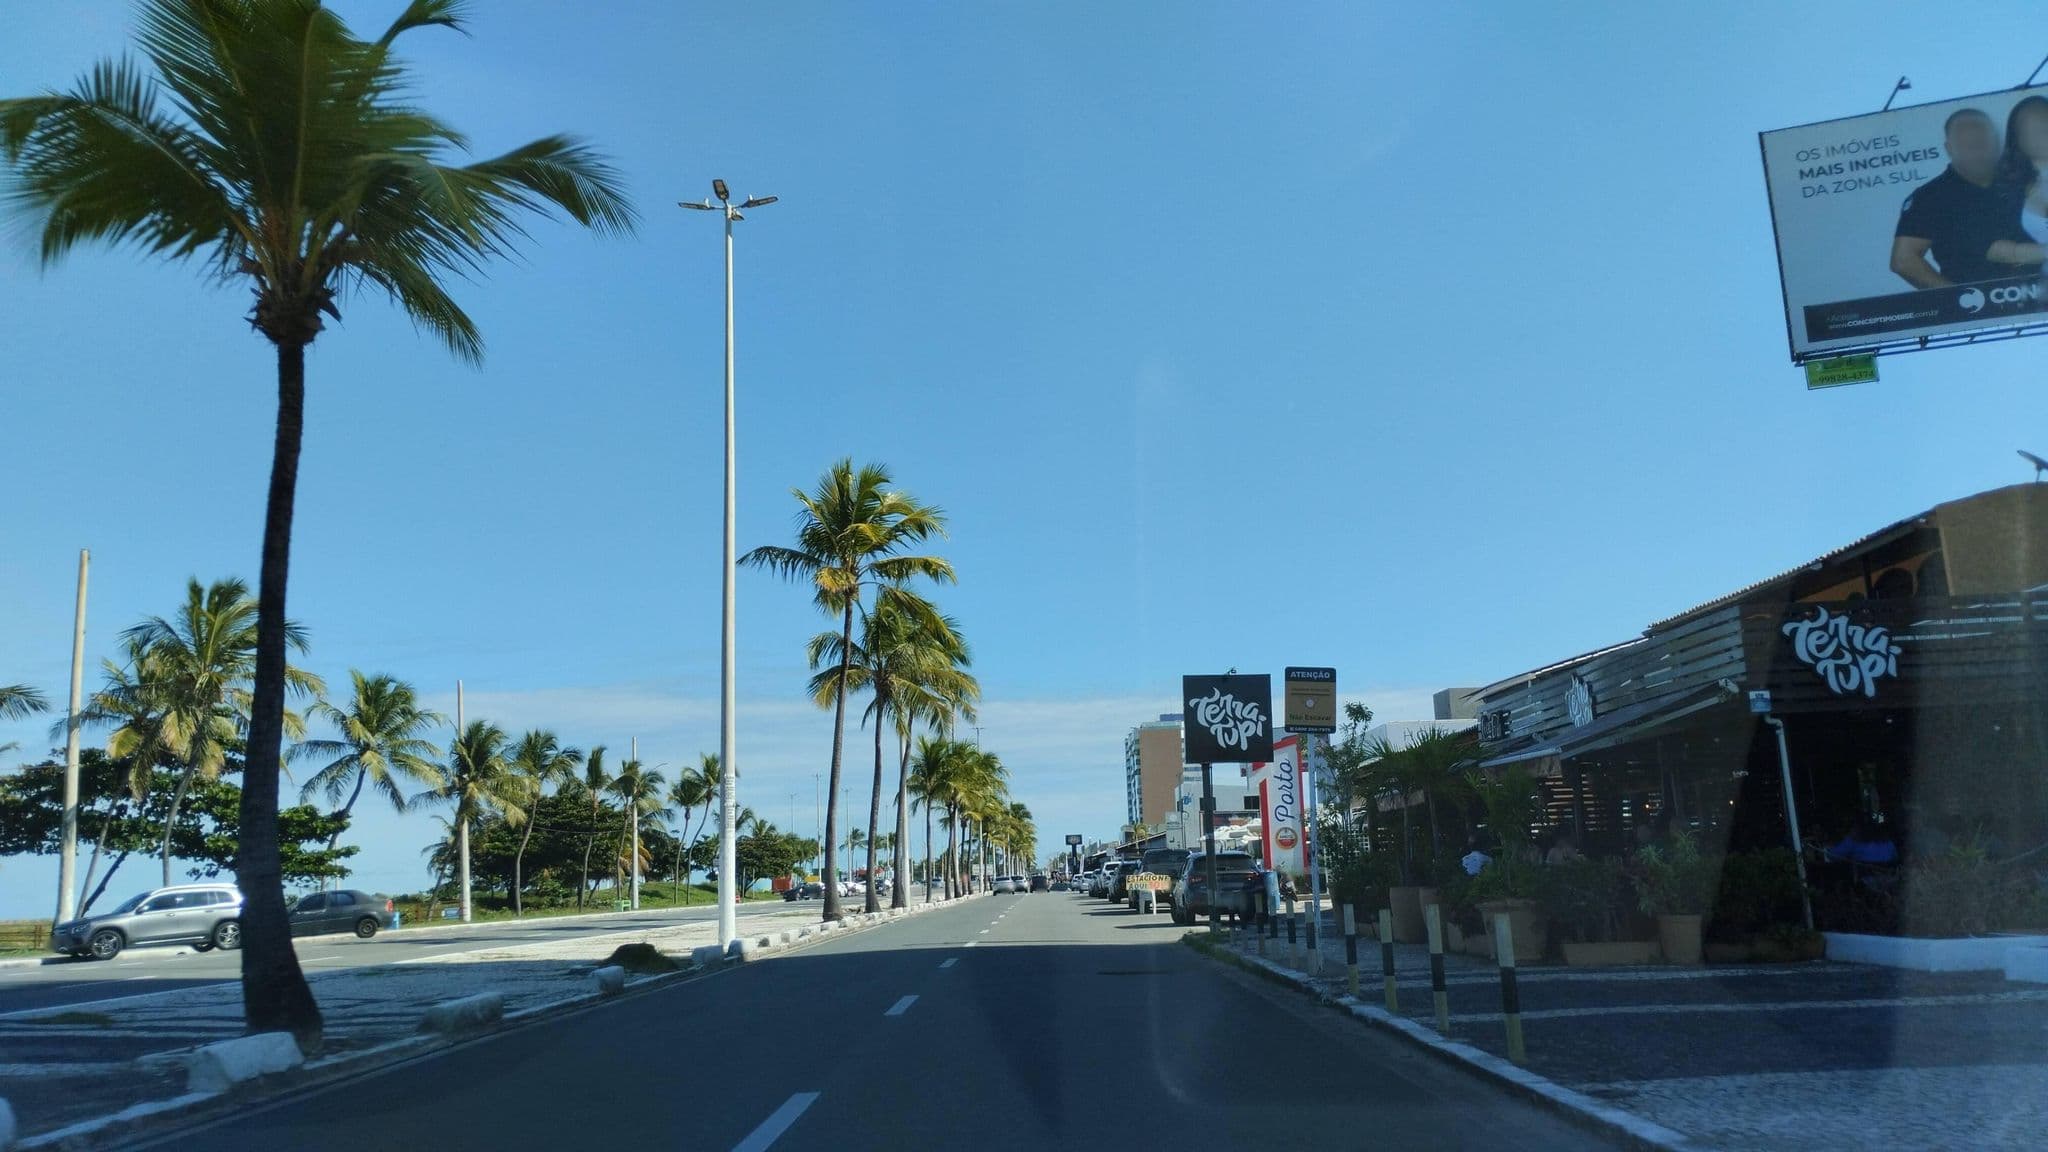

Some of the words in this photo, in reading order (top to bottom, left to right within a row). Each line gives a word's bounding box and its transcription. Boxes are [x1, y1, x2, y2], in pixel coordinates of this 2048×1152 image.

[1796, 148, 1821, 162] OS
[1825, 134, 1900, 157] IMÓVEIS
[1799, 163, 1845, 180] MAIS
[1849, 146, 1940, 172] INCRÍVEIS
[1802, 184, 1828, 199] DA
[1832, 175, 1884, 194] ZONA
[1889, 168, 1928, 184] SUL
[1990, 283, 2042, 304] CON
[1782, 605, 1888, 664] Terra
[1290, 671, 1330, 680] ATENÇÃO
[1816, 646, 1902, 698] Tupi
[1189, 687, 1259, 727] Terra
[1210, 715, 1267, 751] Tupi
[1273, 758, 1295, 822] Porto
